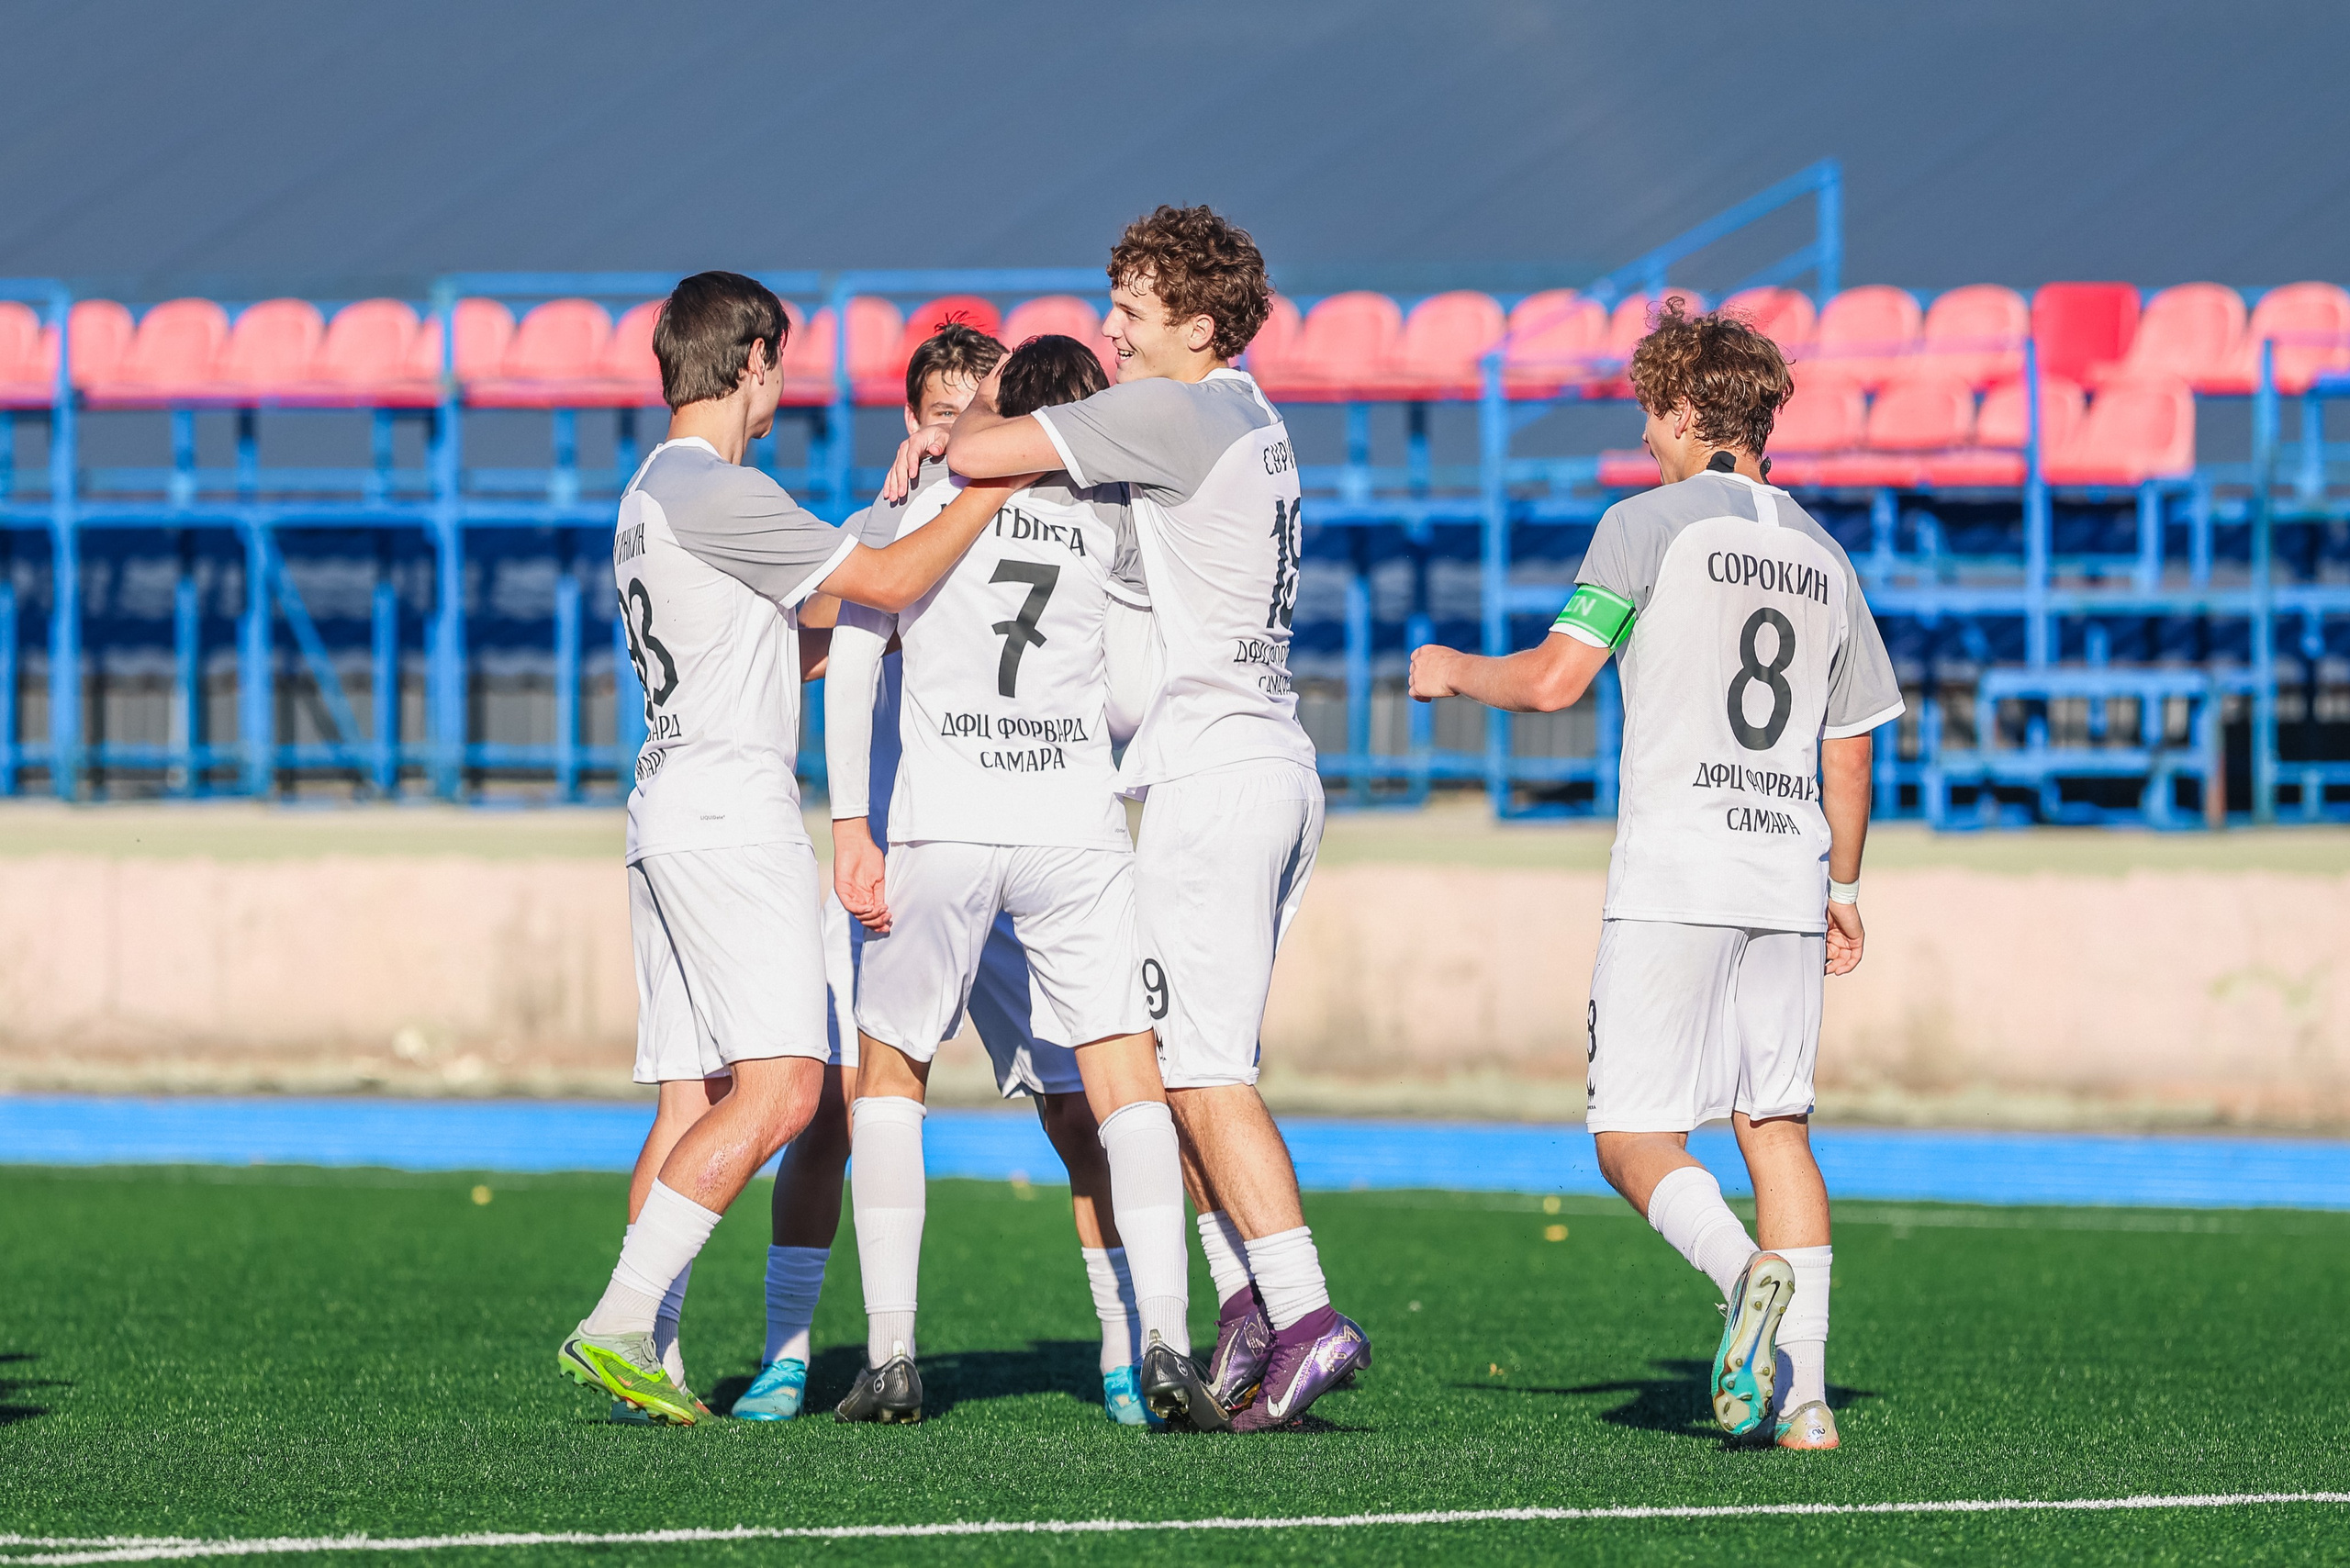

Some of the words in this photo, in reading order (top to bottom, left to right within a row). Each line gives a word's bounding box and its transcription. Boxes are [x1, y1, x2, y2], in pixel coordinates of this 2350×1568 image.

[1707, 551, 1829, 606] СОРОКИН
[988, 558, 1061, 699] 7
[1728, 607, 1796, 751] 8
[941, 711, 992, 740] ДФЦ
[997, 717, 1089, 743] ФОРВАРД
[979, 747, 1066, 773] САМАРА
[1693, 762, 1746, 792] ДФЦ
[1746, 767, 1818, 802] ФОРВАР
[1726, 807, 1801, 835] САМАРА
